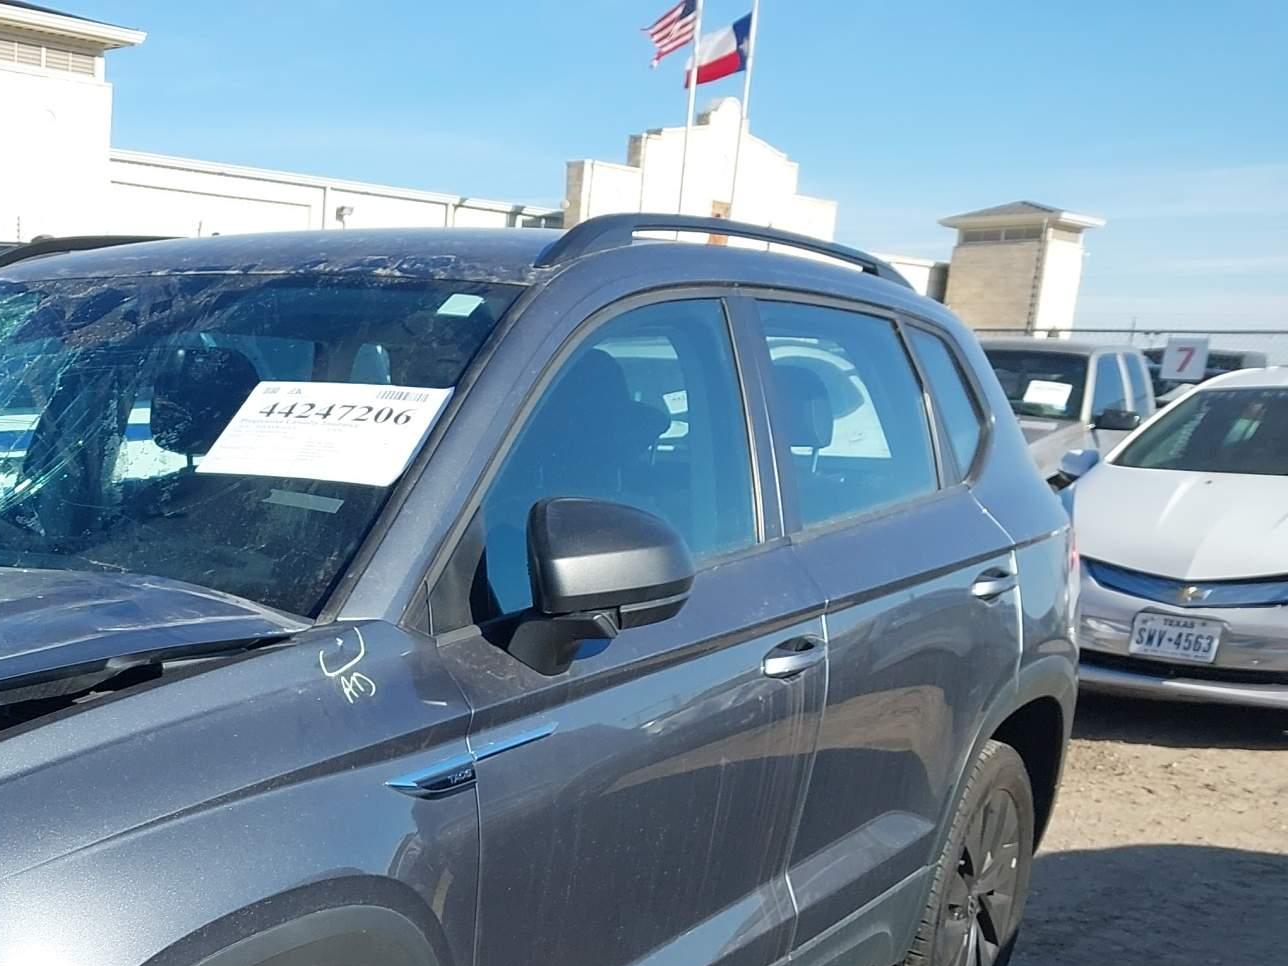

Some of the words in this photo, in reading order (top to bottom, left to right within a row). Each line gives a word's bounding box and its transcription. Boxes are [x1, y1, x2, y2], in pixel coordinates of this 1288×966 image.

[1176, 346, 1196, 373] 7
[260, 401, 415, 426] 44247206
[1163, 617, 1195, 629] TEXAS
